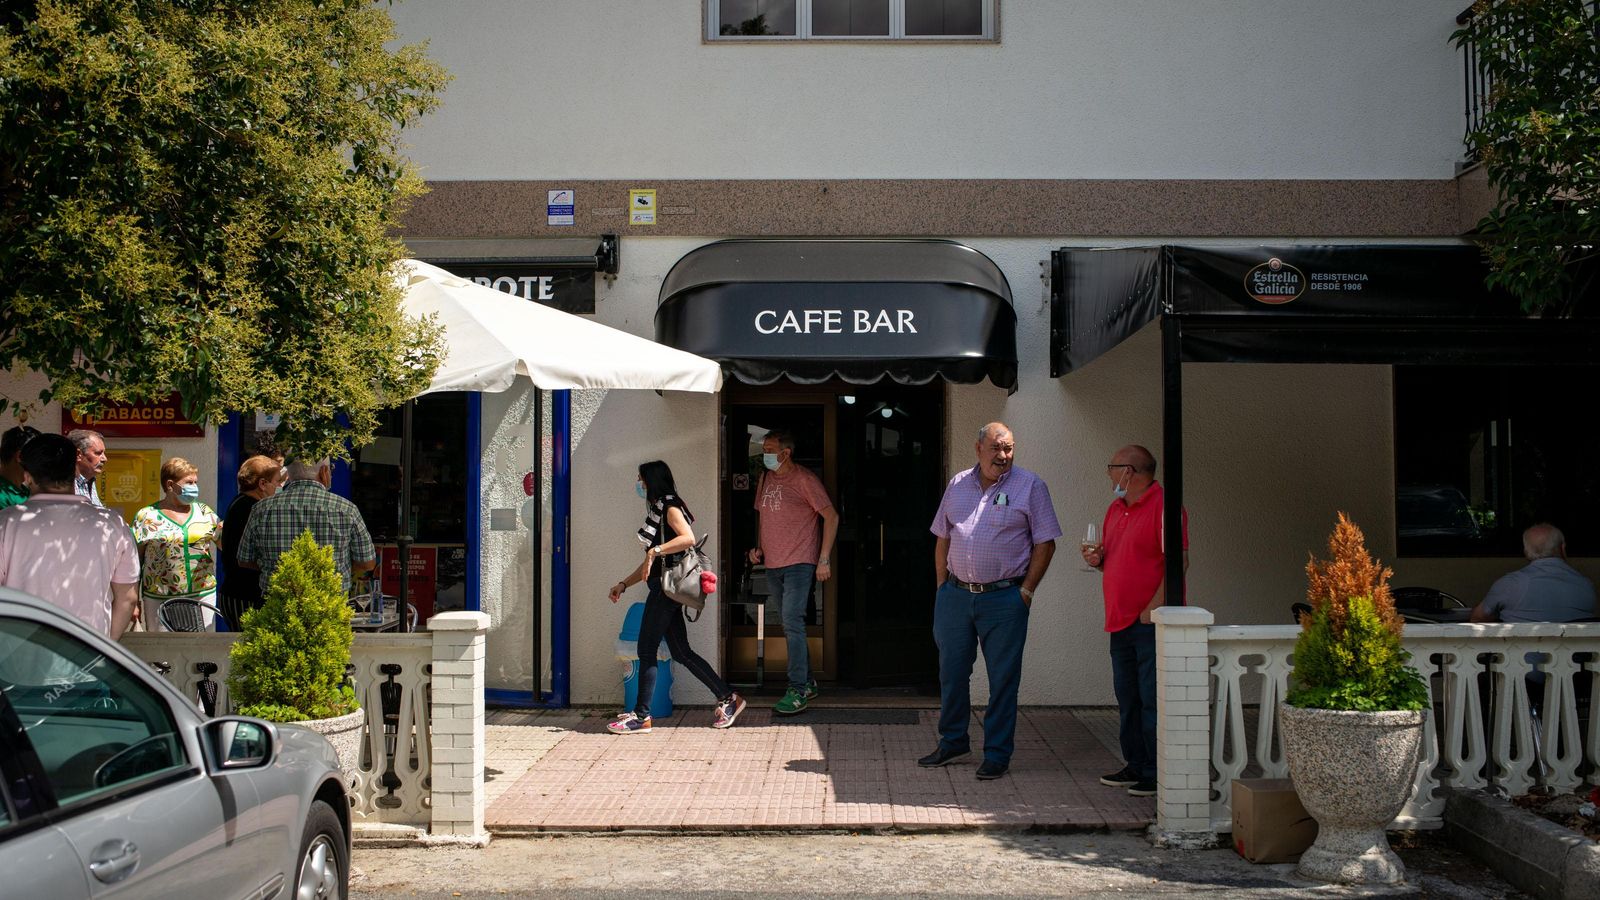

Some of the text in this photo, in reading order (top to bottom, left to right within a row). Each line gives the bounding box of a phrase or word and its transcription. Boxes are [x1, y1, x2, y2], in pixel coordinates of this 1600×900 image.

[1253, 271, 1298, 283] Estrella
[1311, 273, 1369, 281] RESISTENCIA
[1255, 282, 1295, 295] Galicia
[1343, 283, 1362, 291] 1906
[754, 309, 918, 335] CAFE BAR
